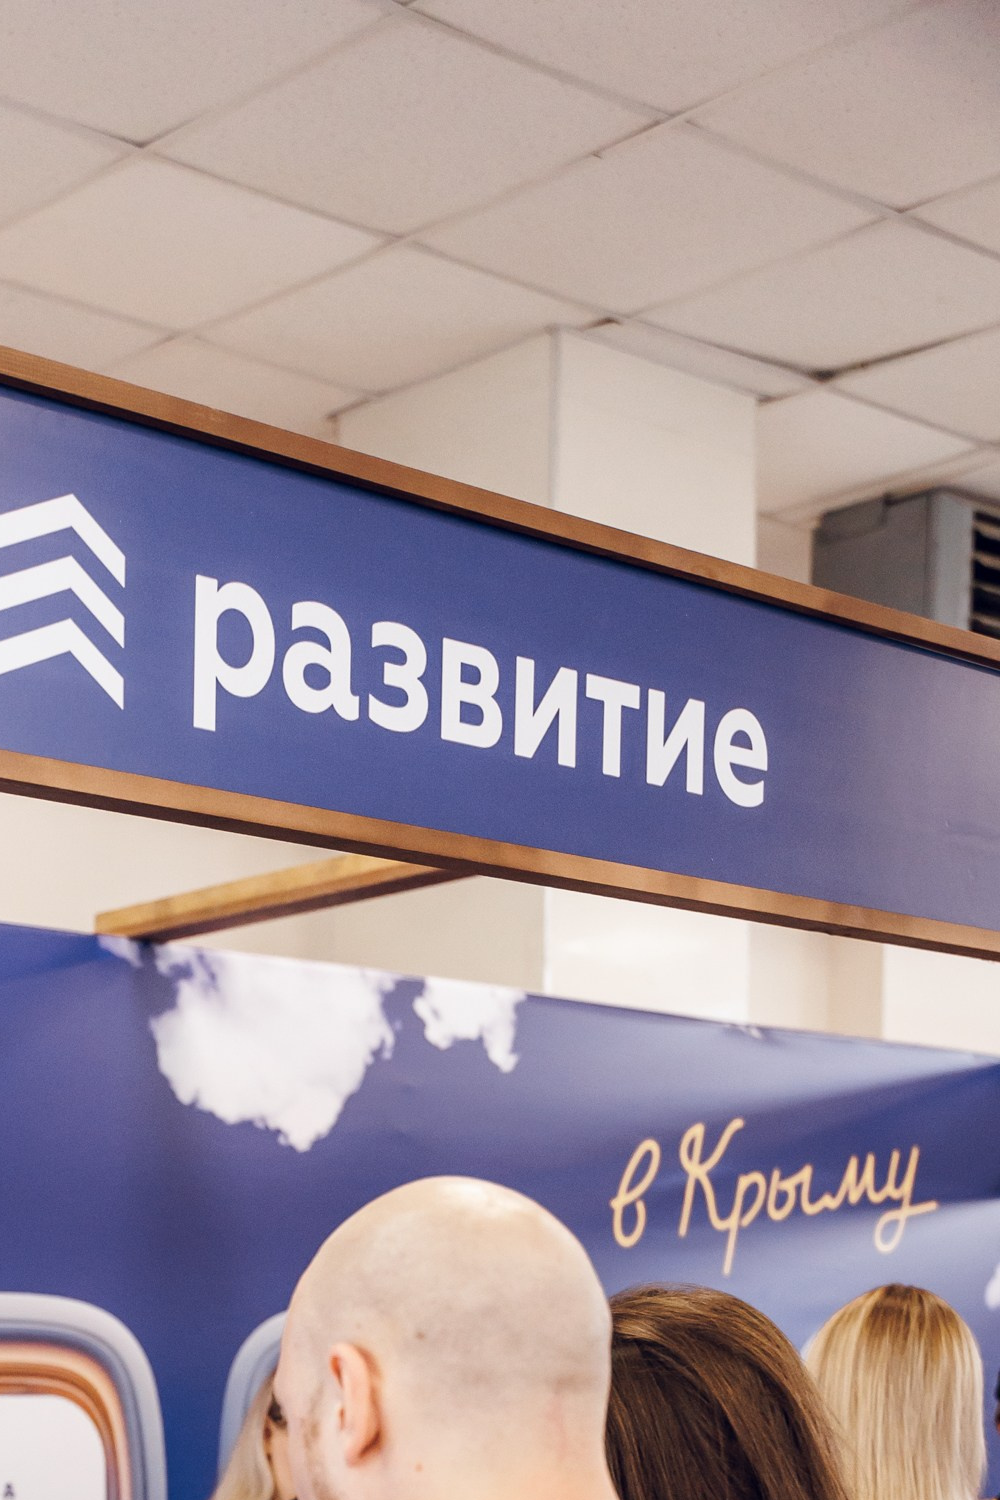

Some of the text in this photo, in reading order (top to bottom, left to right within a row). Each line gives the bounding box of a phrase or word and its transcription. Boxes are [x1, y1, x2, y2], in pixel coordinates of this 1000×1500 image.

[193, 574, 769, 809] развитие
[610, 1117, 939, 1277] в Крыму
